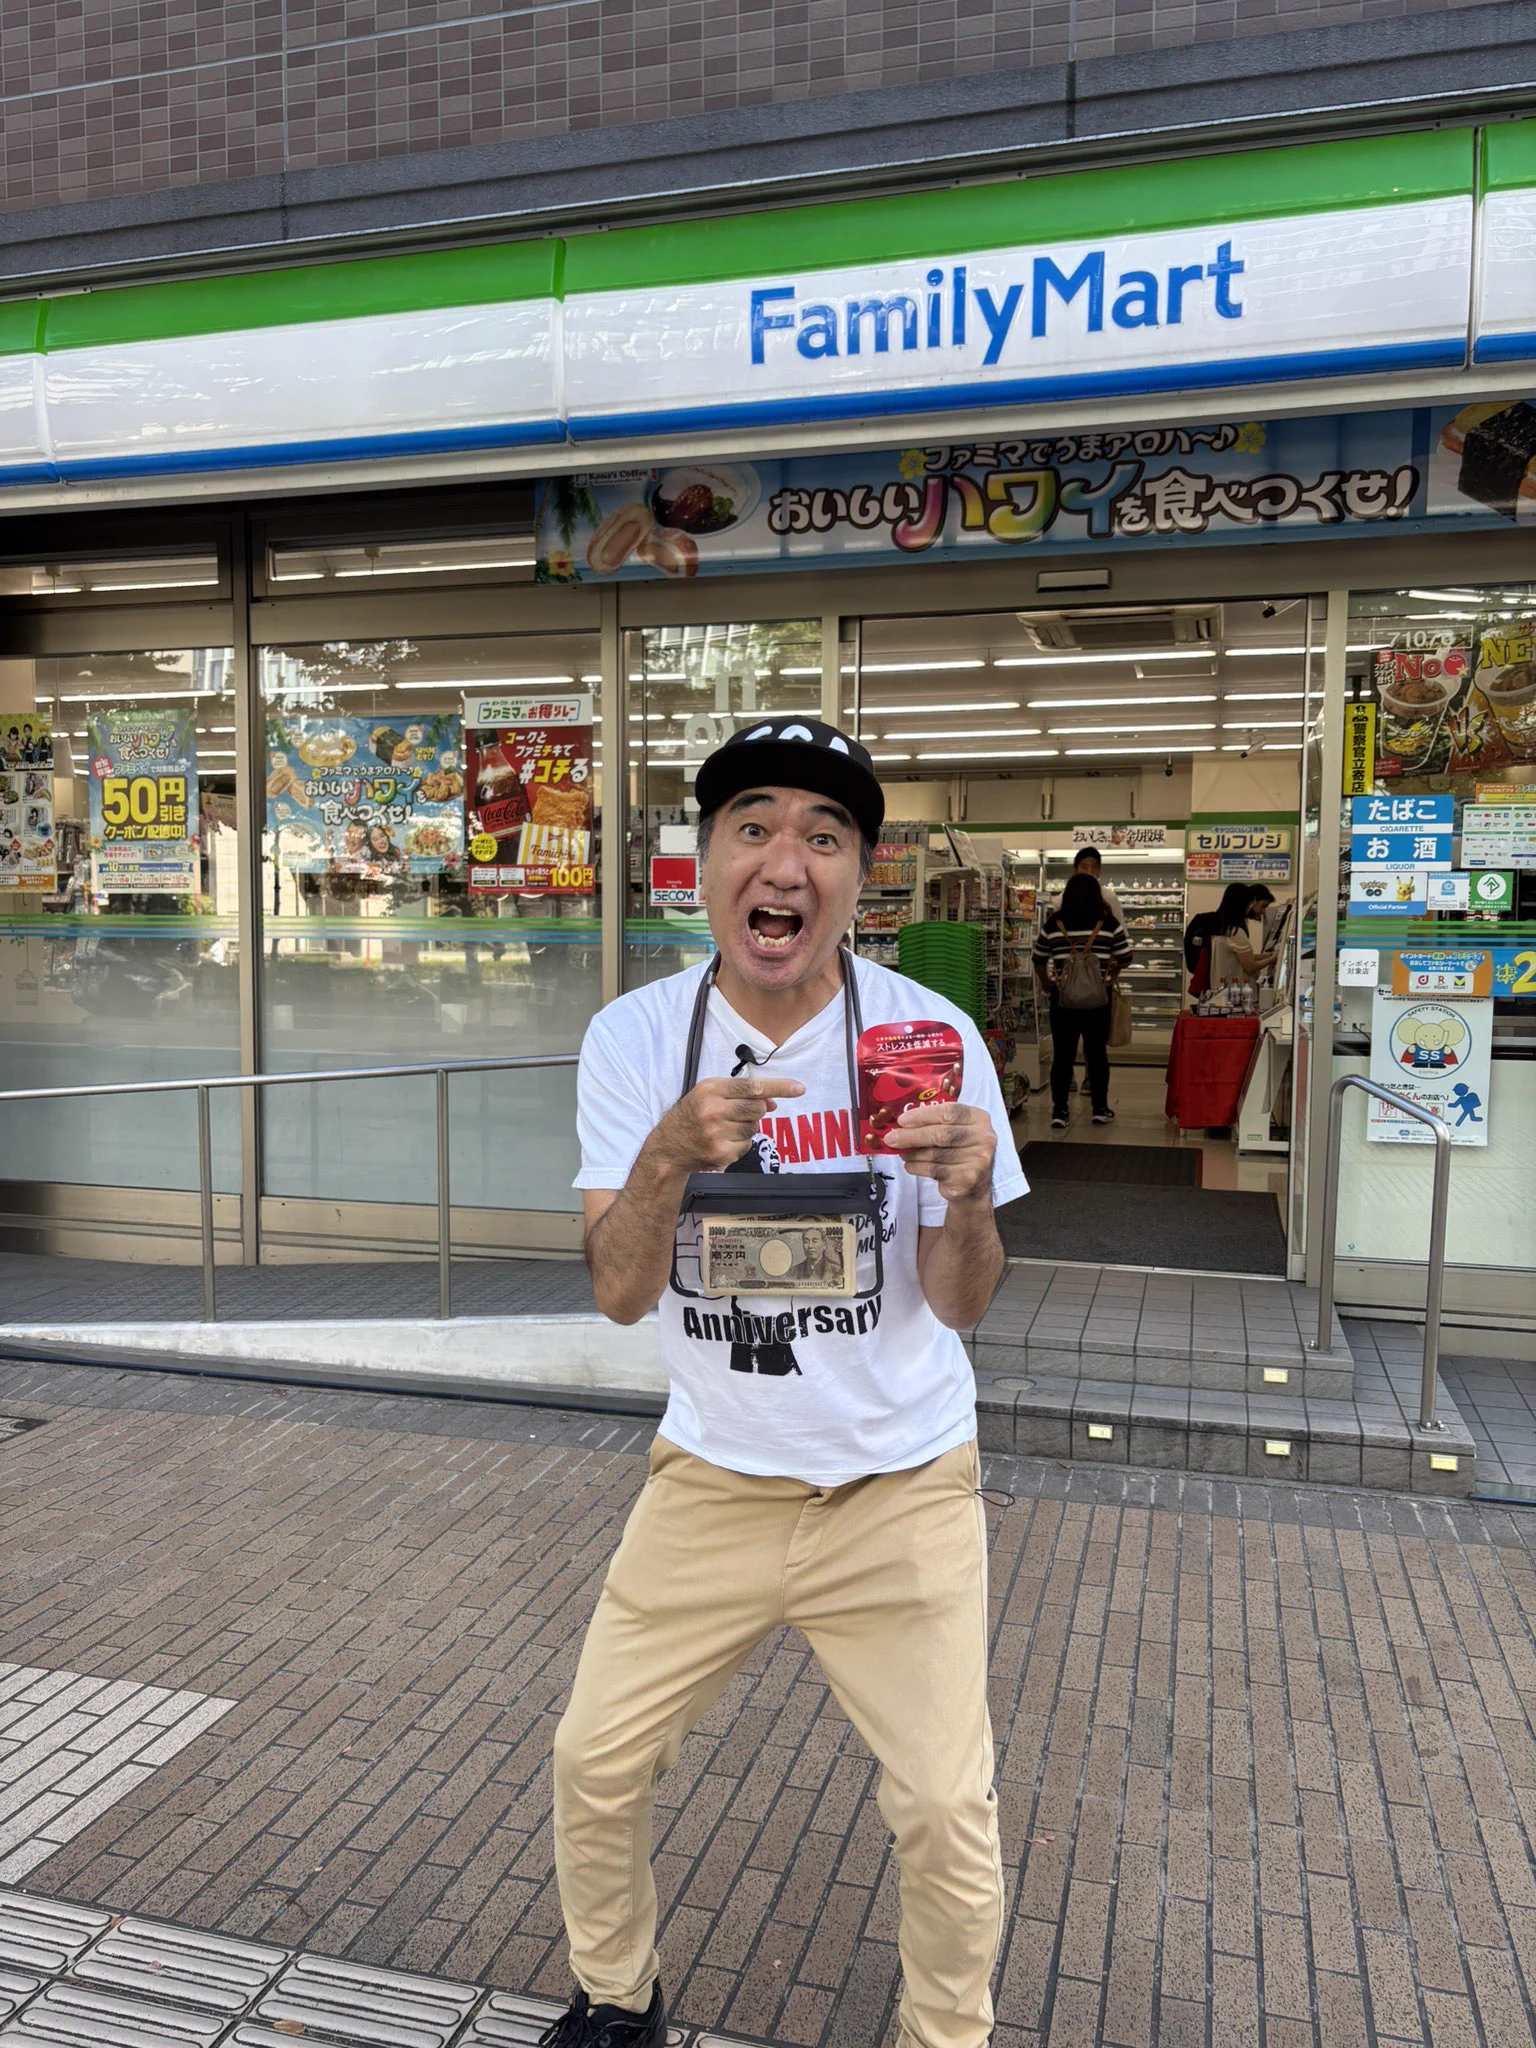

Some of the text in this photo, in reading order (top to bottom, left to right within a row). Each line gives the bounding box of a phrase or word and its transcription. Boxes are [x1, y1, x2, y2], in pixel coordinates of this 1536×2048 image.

[750, 239, 1246, 366] FamilyMart
[1481, 636, 1536, 669] NE
[506, 731, 548, 745] コークと
[515, 743, 576, 757] ファミチキで
[1351, 722, 1368, 793] 警察官立寄店
[305, 777, 427, 806] おいしいハワイを
[1368, 798, 1438, 822] たばこ
[1380, 825, 1424, 833] CIGARETTE
[1197, 834, 1282, 849] セルフレジ
[653, 890, 695, 902] SECOM
[1366, 888, 1382, 897] GO
[1340, 960, 1377, 968] インボイス
[1347, 967, 1369, 975] 対象店
[1407, 1006, 1456, 1018] SAFETY STATION
[876, 1039, 946, 1052] ストレスを低減する
[1418, 1050, 1440, 1061] SS
[825, 1226, 844, 1236] 10000
[682, 1295, 883, 1347] Anniversary
